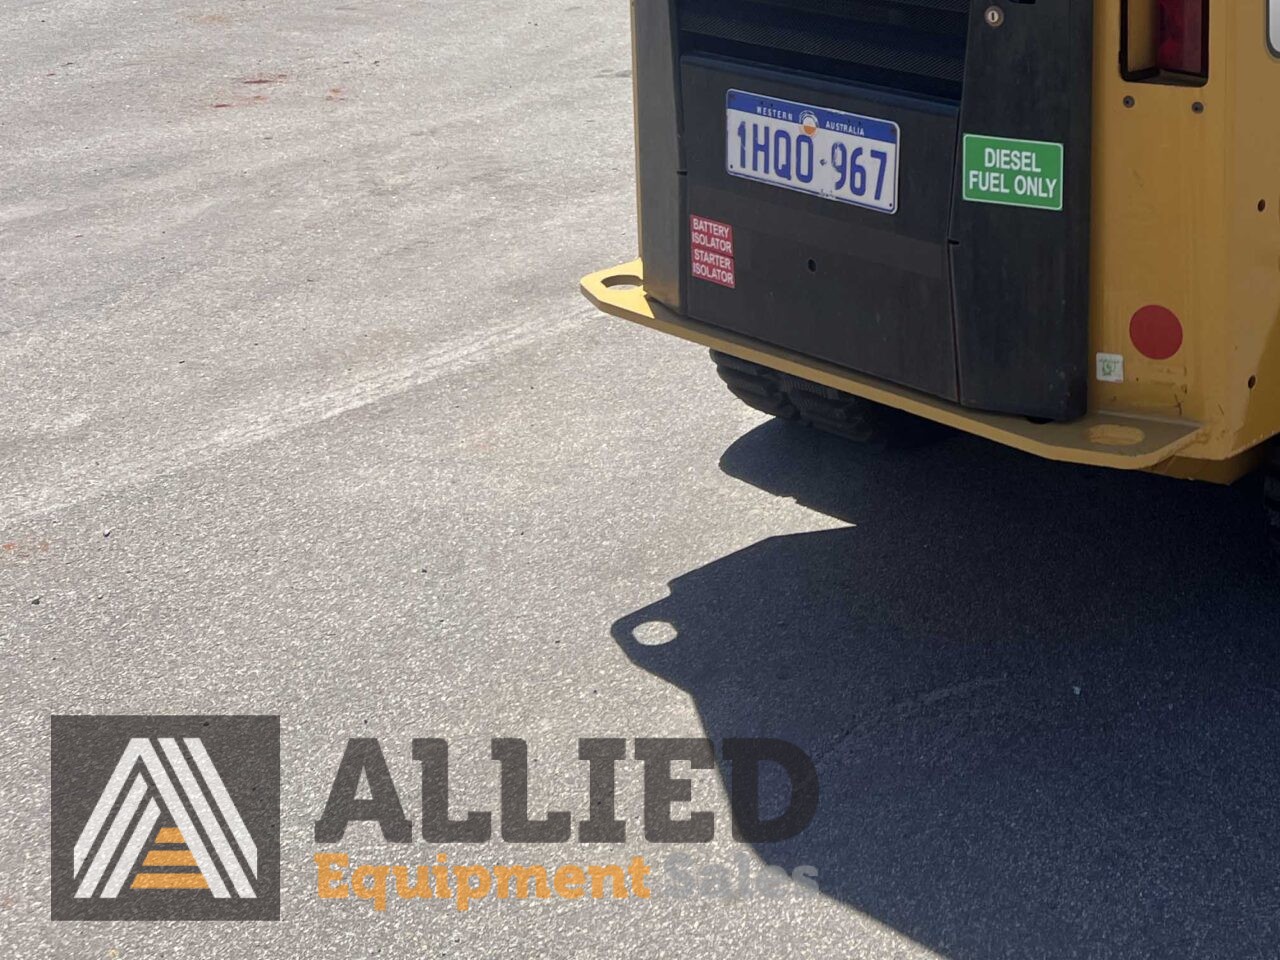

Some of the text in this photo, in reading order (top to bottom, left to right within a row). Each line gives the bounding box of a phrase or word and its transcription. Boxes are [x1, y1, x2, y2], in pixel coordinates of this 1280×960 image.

[756, 106, 865, 136] WESTERN AUSTRALIA
[984, 147, 1042, 173] DIESEL
[968, 170, 1058, 199] FUEL ONLY
[693, 218, 729, 238] BATTERY
[691, 231, 732, 254] ISOLATOR
[694, 248, 731, 270] STARTER
[692, 262, 734, 284] ISOLATOR
